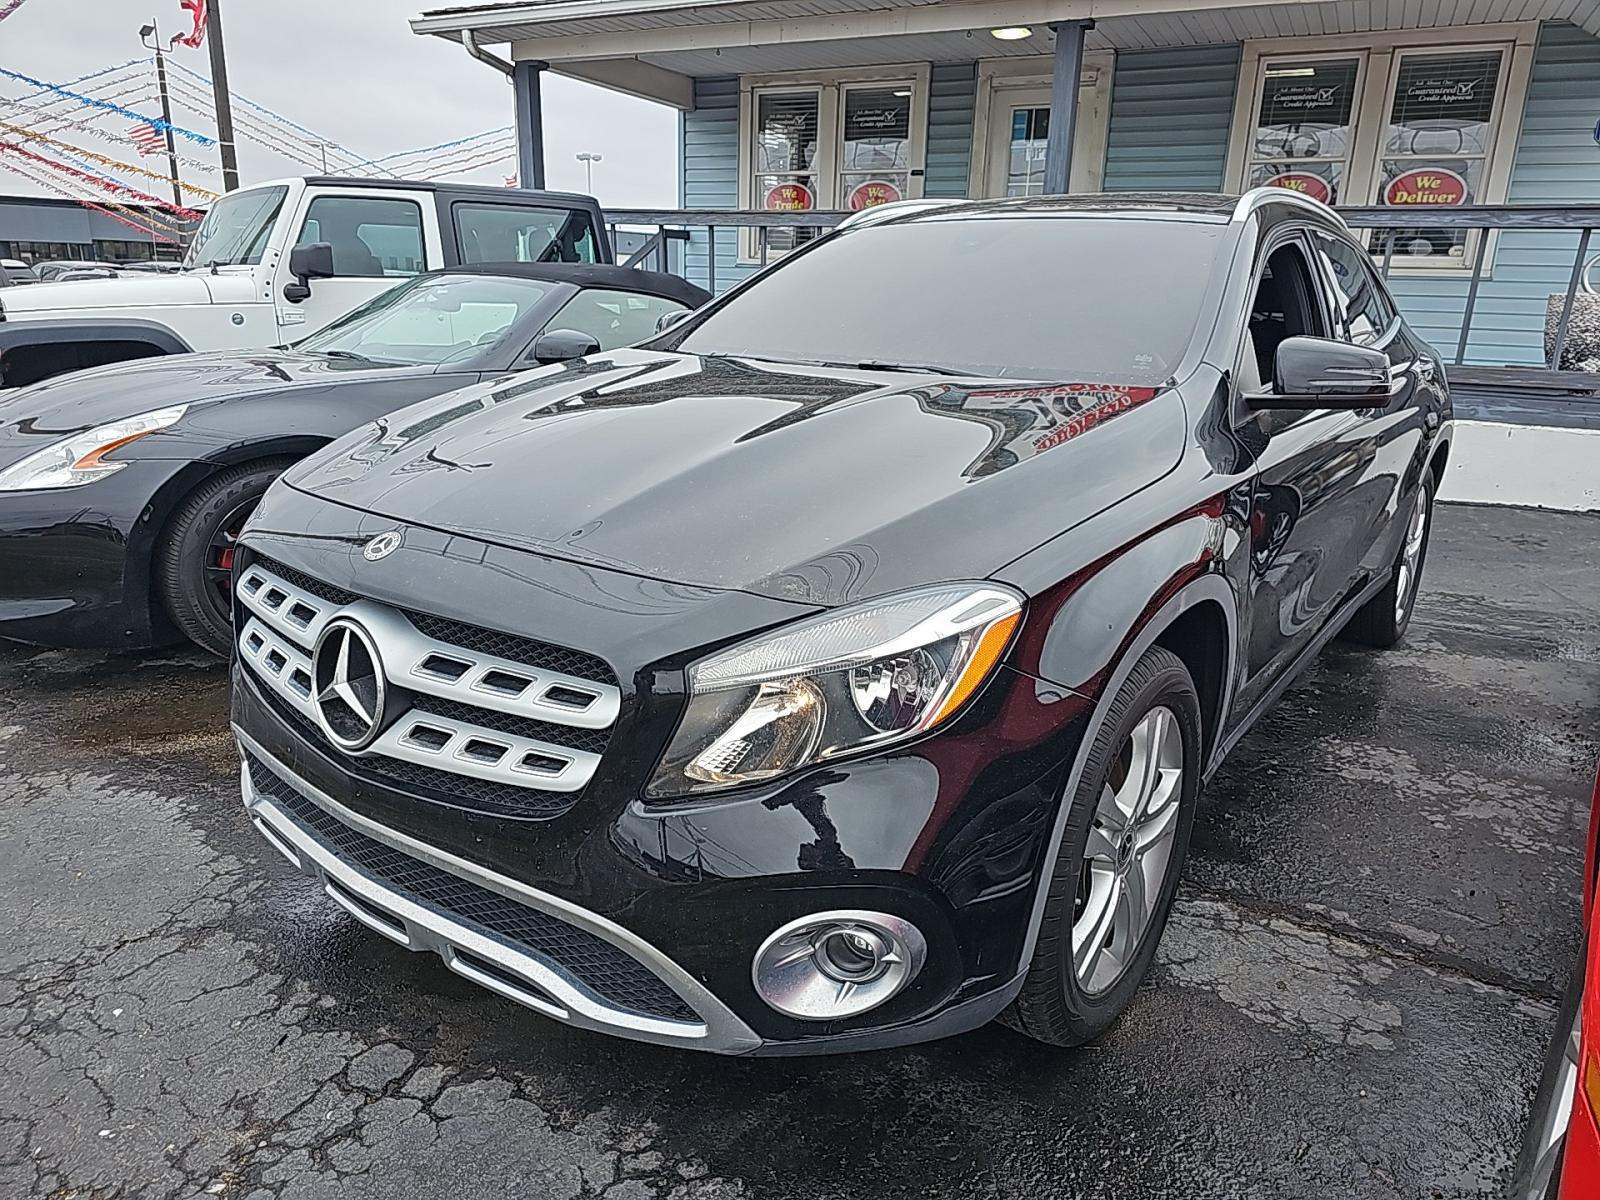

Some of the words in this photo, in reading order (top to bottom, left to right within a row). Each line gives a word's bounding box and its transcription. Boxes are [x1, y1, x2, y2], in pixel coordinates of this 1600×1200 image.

[1408, 86, 1458, 95] Guaranteed
[1273, 92, 1320, 101] Guaranteed
[1415, 176, 1441, 189] We
[781, 188, 798, 199] We
[868, 185, 884, 198] We
[1394, 191, 1456, 203] Deliver
[774, 200, 804, 210] Trade
[195, 480, 256, 537] EAGLE
